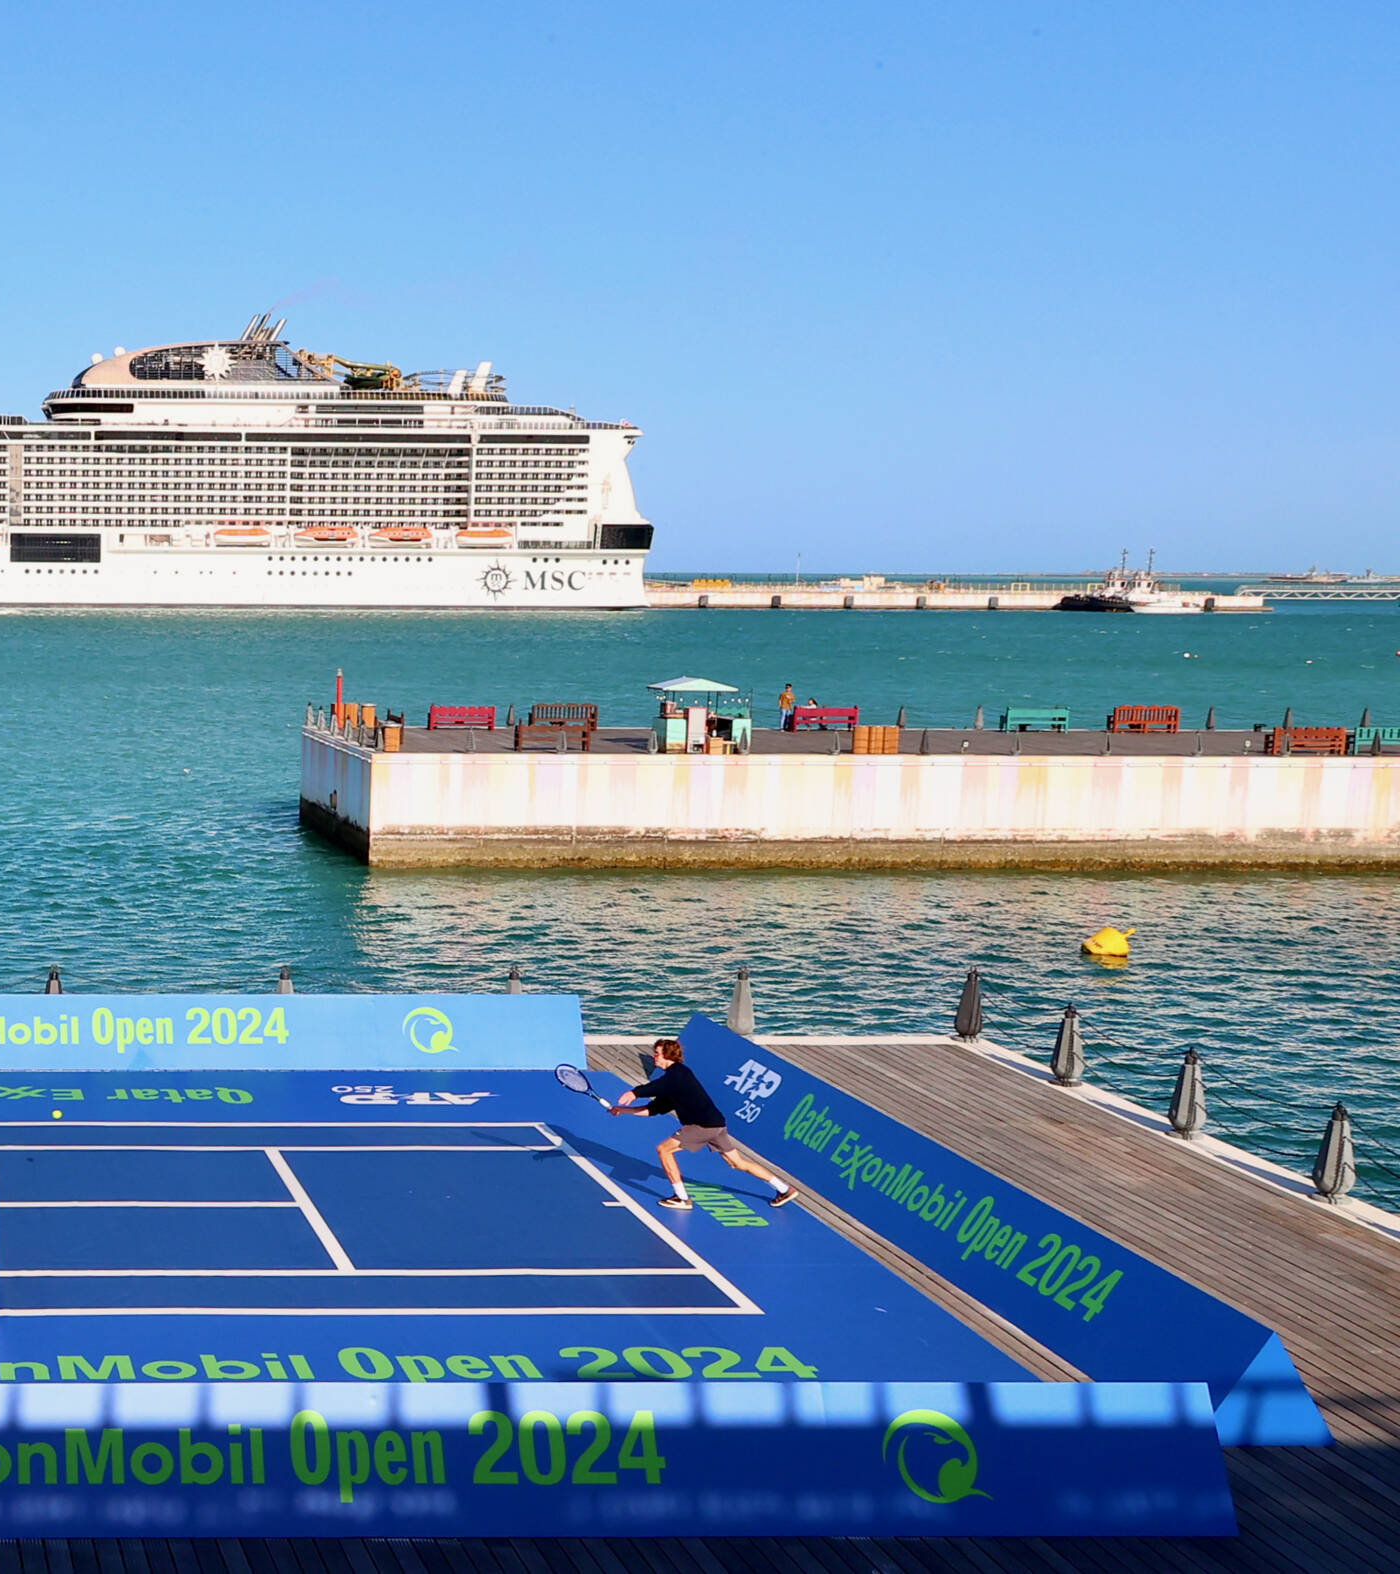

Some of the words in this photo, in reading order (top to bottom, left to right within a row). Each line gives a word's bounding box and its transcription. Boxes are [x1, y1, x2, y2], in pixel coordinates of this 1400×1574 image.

[524, 570, 586, 591] MSC
[92, 1007, 174, 1053] Open
[185, 1007, 290, 1045] 2024
[331, 1085, 394, 1093] 250
[723, 1059, 783, 1100] ATP
[107, 1085, 253, 1104] Qatar
[339, 1092, 500, 1105] ATP
[734, 1100, 763, 1123] 250
[783, 1093, 842, 1153] Qatar
[830, 1130, 967, 1231] ExxonMobil
[955, 1195, 1028, 1270] Open
[1015, 1232, 1125, 1322] 2024
[338, 1347, 543, 1382] Open
[559, 1346, 819, 1379] 2024
[289, 1410, 446, 1503] Open
[467, 1409, 667, 1486] 2024
